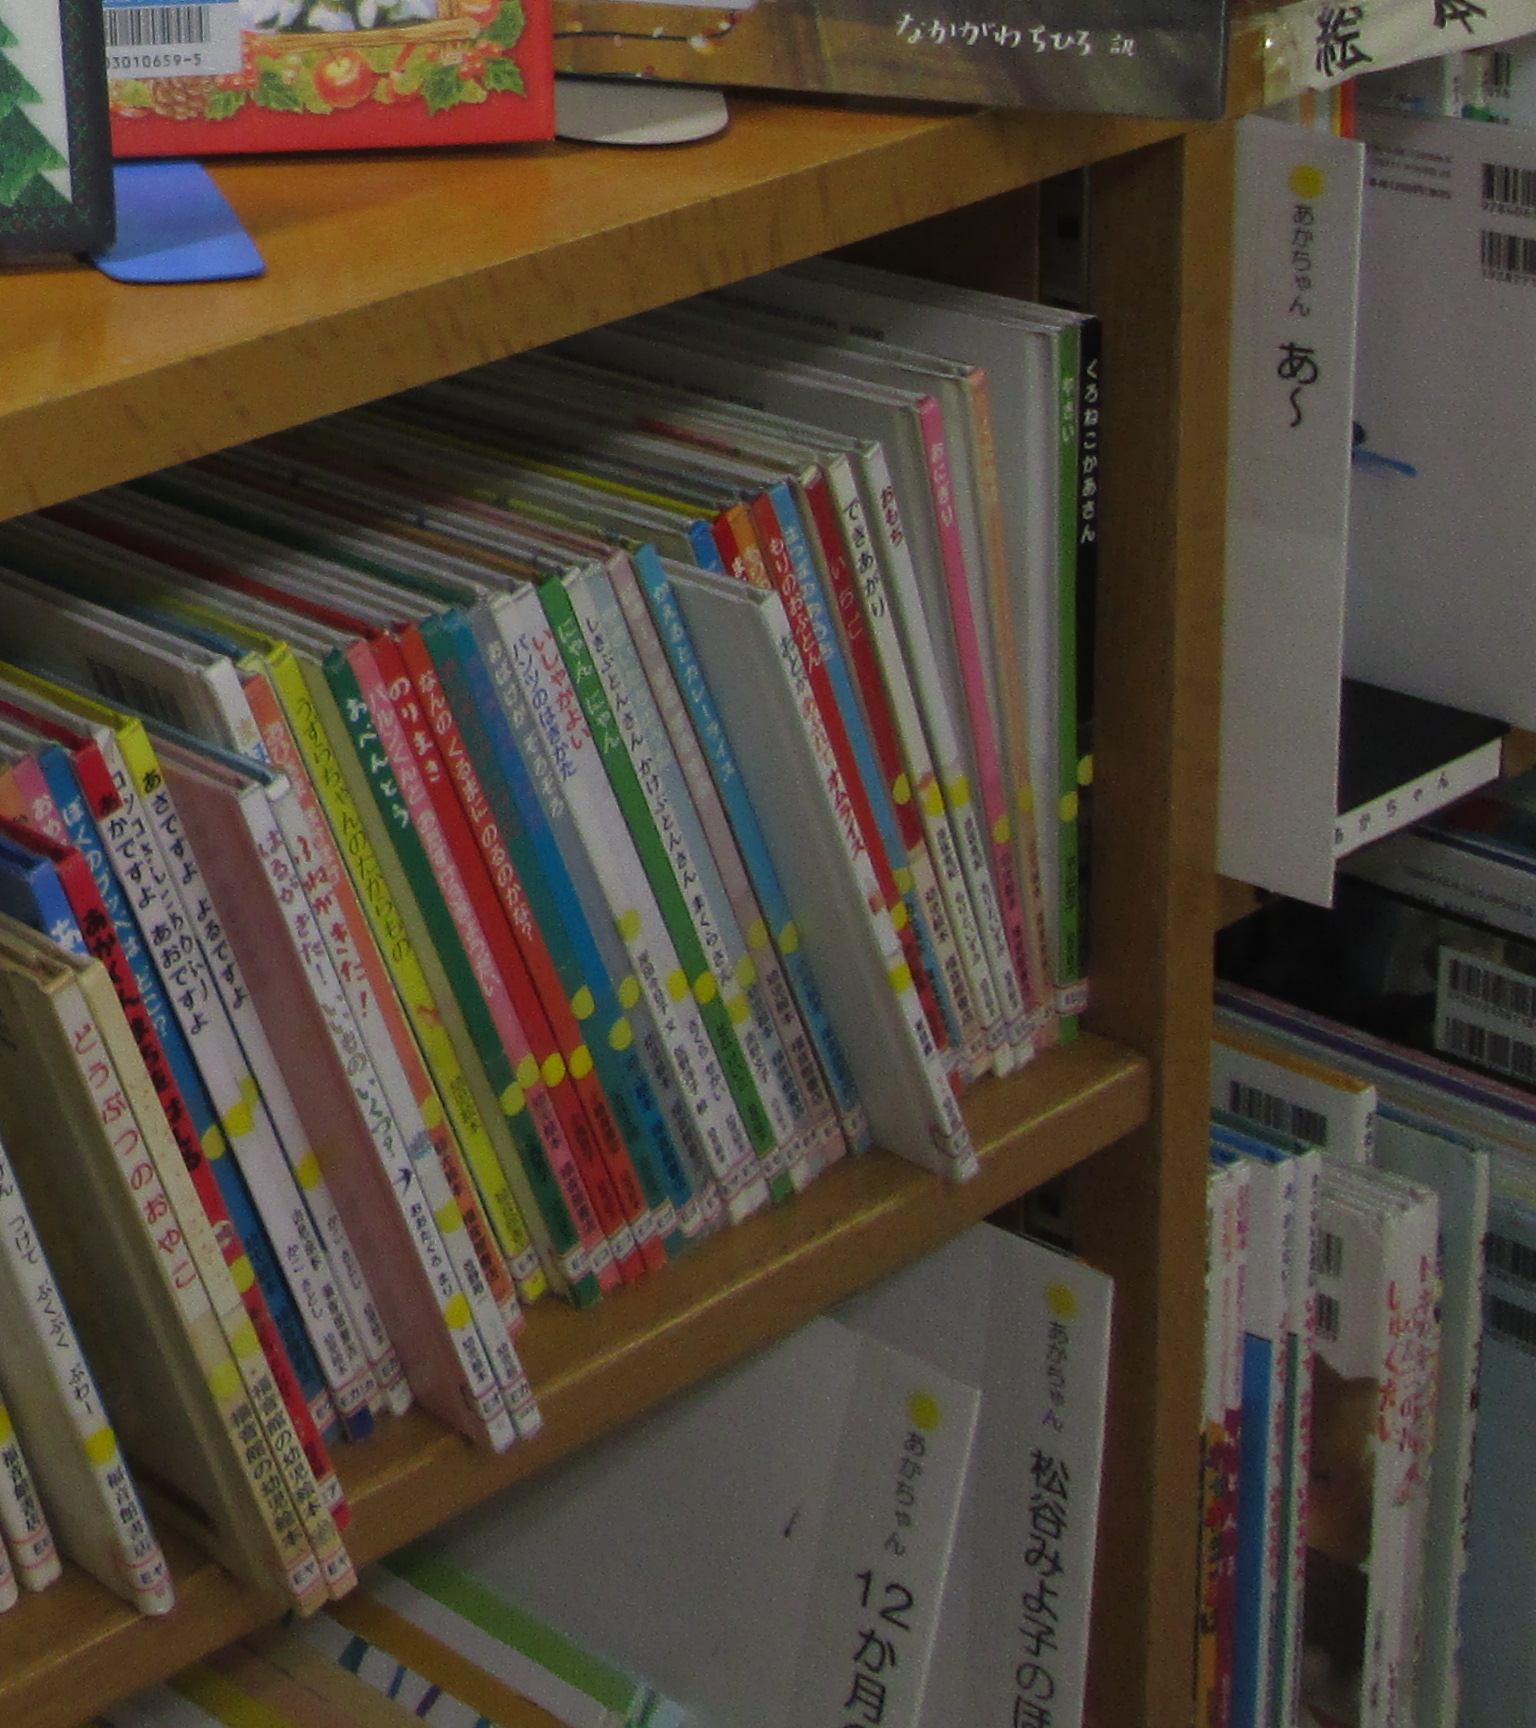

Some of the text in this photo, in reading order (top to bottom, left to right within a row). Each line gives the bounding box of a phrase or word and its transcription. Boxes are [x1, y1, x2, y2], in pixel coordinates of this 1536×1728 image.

[896, 11, 1021, 49] なかがわ
[1029, 21, 1094, 56] ちひろ
[1290, 204, 1317, 318] あかちゃん
[98, 792, 157, 910] あかですよ
[151, 923, 209, 1036] あおですよ
[143, 770, 250, 1010] あさですよ よるですよ
[75, 1022, 197, 1291] どうぶつのおやこ
